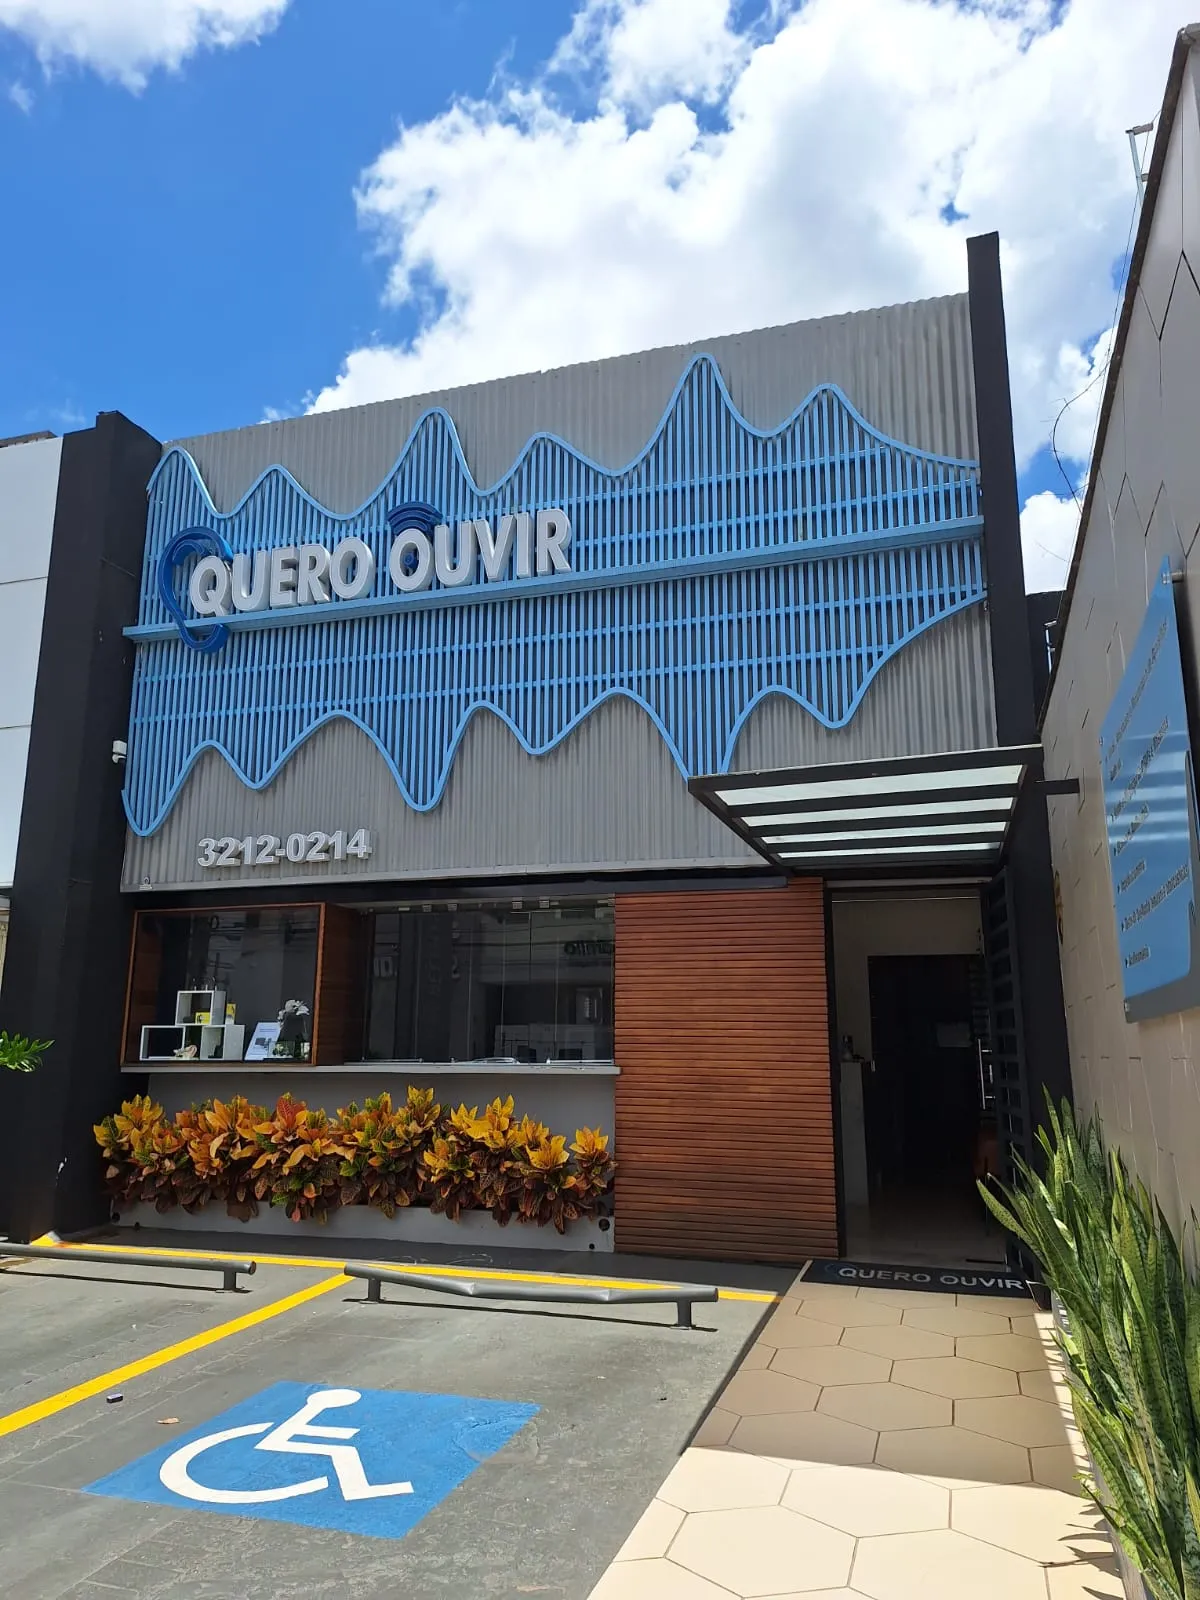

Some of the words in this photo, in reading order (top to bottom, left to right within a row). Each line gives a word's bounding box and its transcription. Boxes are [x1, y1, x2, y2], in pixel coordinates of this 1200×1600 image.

[189, 536, 376, 616] QUERO
[389, 508, 573, 593] OUVIR
[197, 828, 373, 867] 3212-0214
[838, 1266, 931, 1283] QUERO
[940, 1274, 1025, 1290] OUVIR
